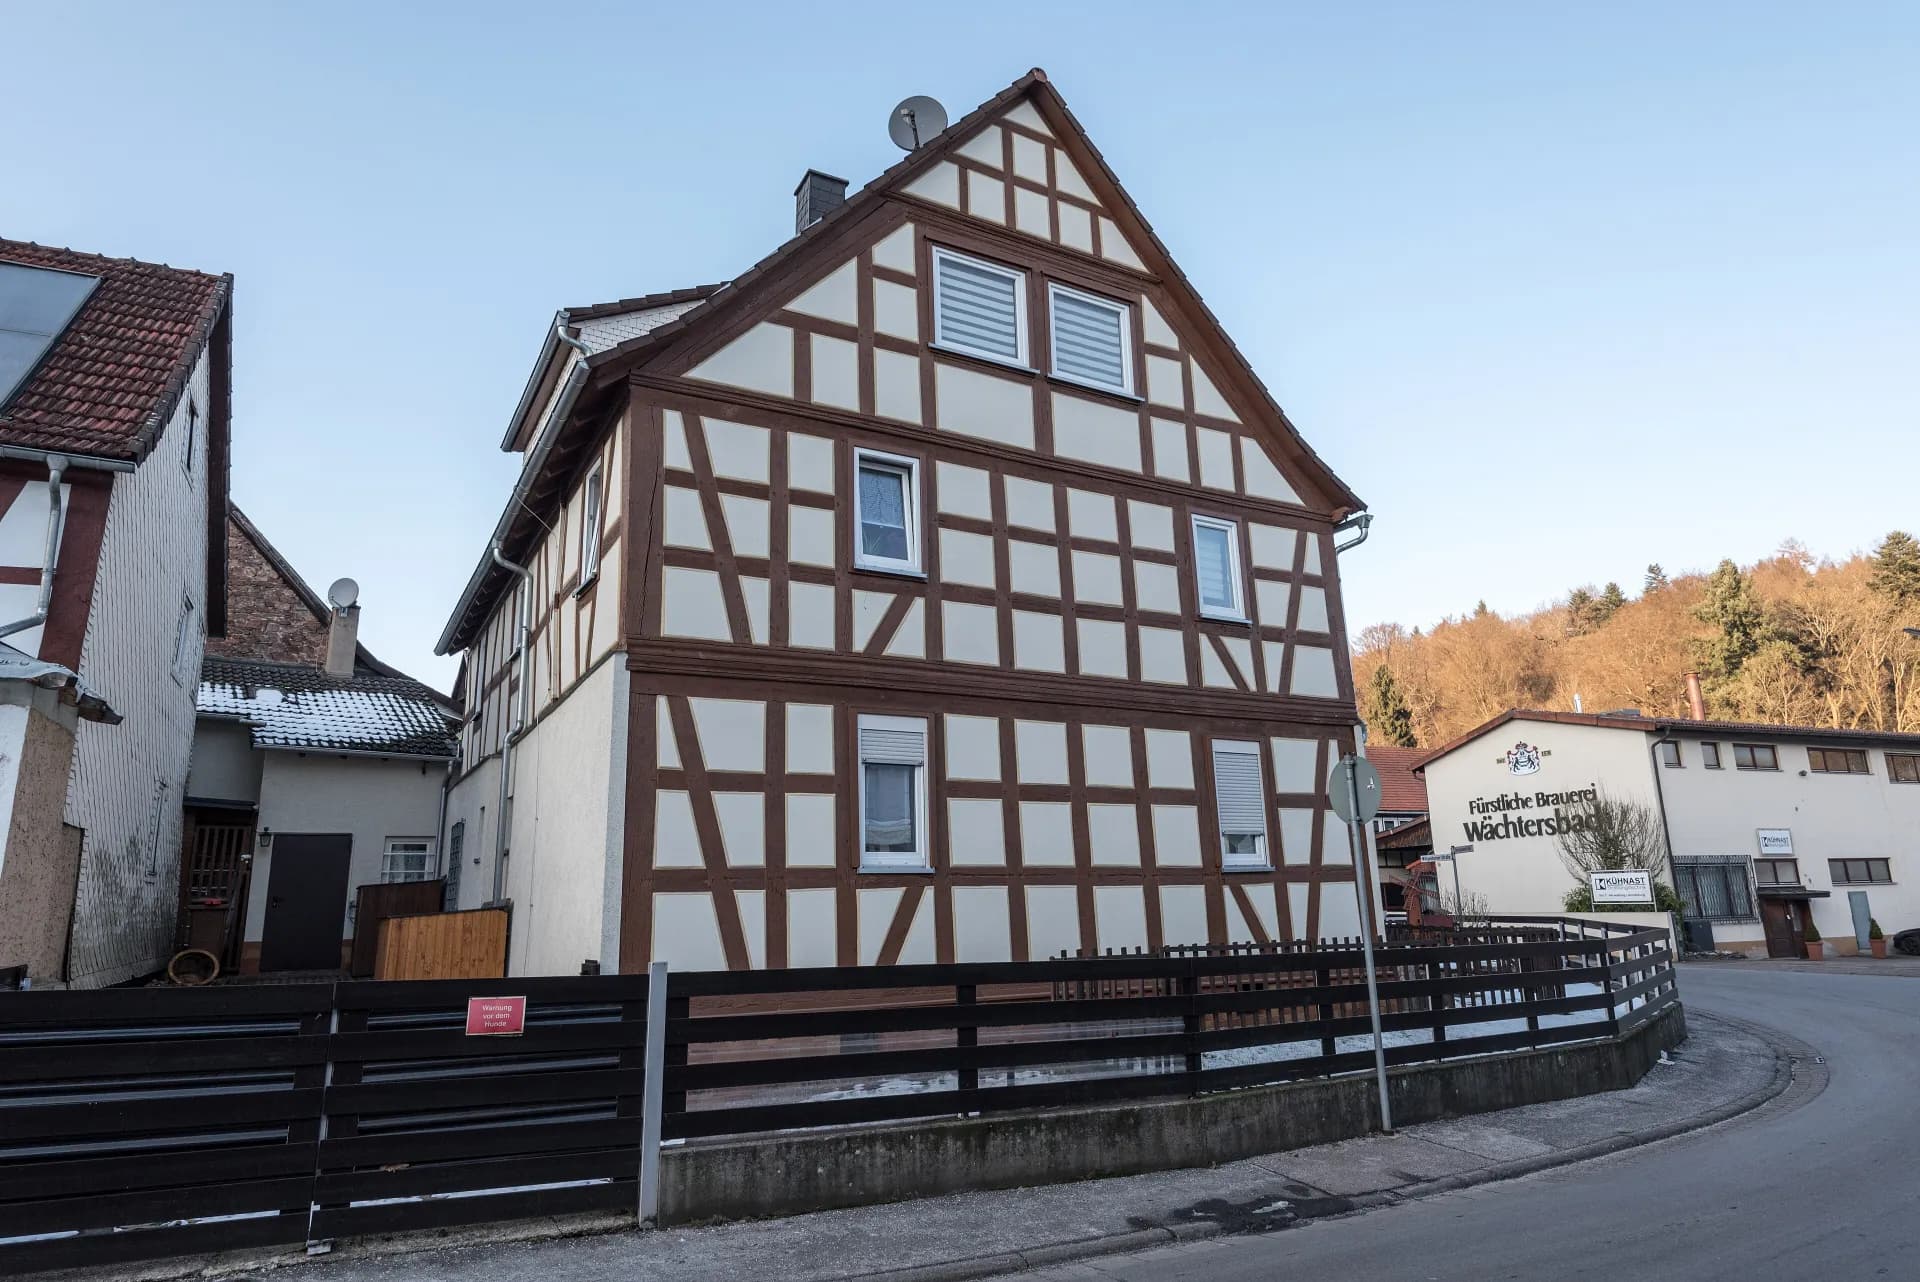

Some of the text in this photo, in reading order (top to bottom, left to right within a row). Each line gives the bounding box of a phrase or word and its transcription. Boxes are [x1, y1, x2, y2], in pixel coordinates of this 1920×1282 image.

[1469, 783, 1597, 815] Fürstliche Brauerei
[1606, 876, 1645, 885] KÜHNAST
